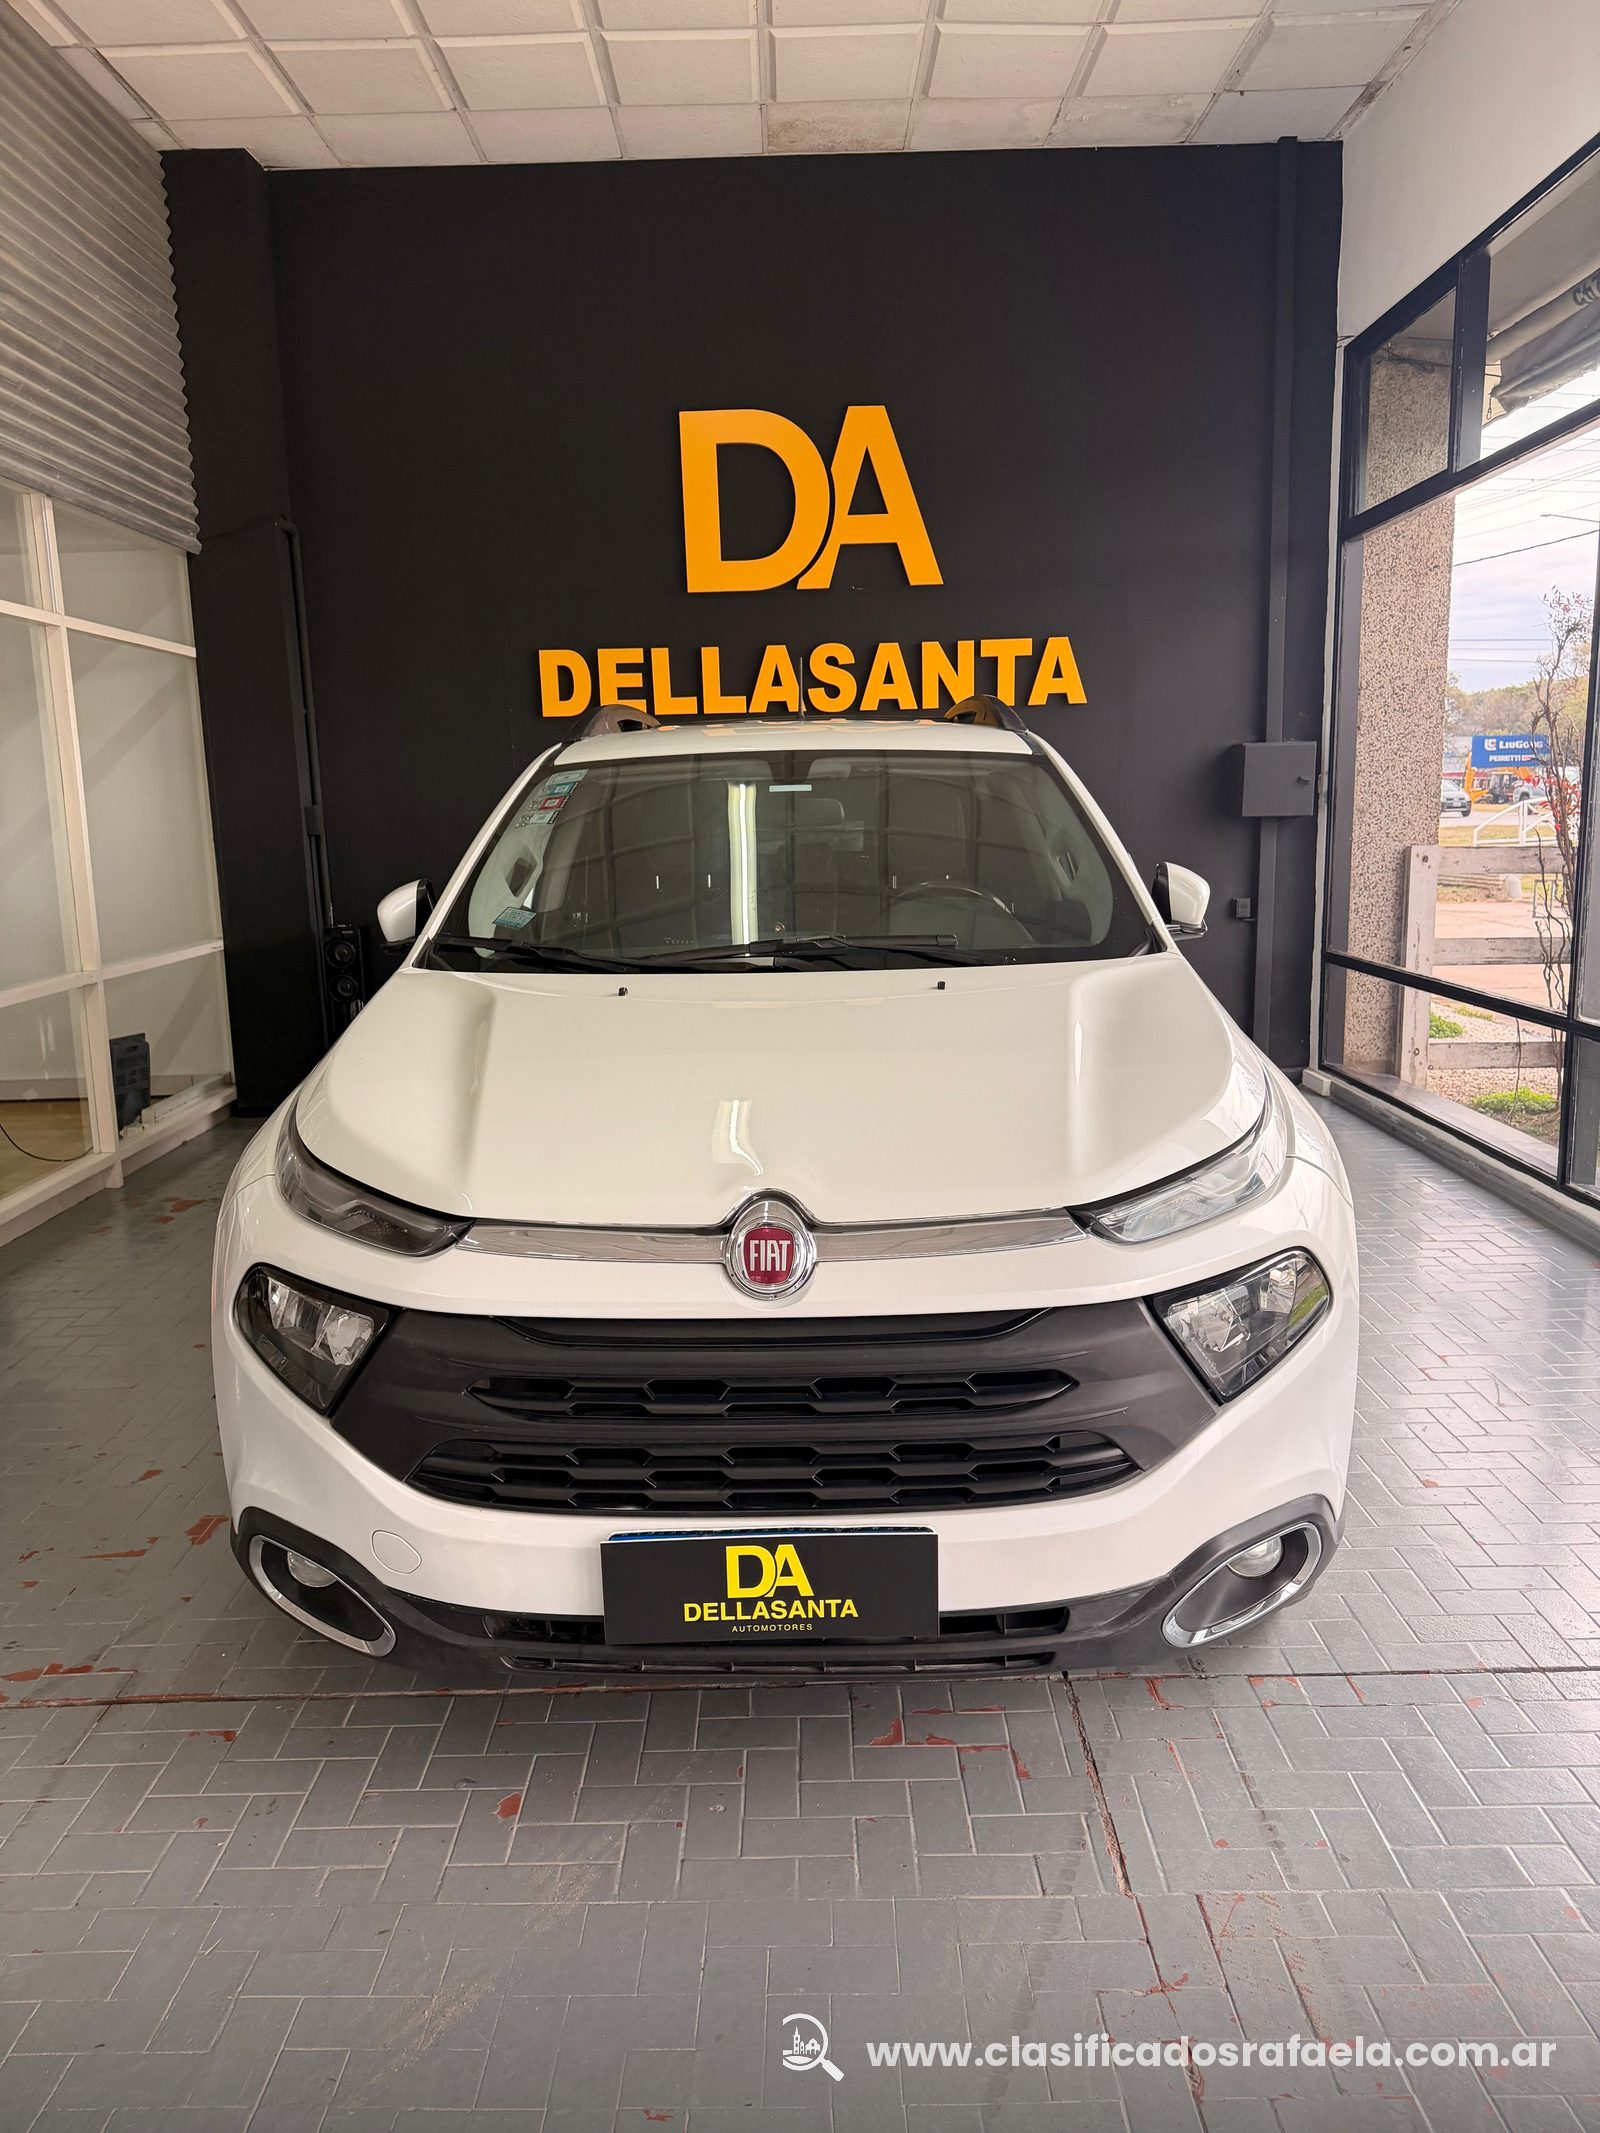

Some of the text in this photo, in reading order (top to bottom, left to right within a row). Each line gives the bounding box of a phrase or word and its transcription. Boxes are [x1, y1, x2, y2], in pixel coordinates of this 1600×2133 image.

[679, 405, 943, 593] DA
[539, 637, 1086, 717] DELLASANTA
[750, 1240, 791, 1271] FIAT
[726, 1544, 814, 1598] DA
[683, 1599, 858, 1622] DELLASANTA
[731, 1623, 813, 1633] AUTOMOTORES
